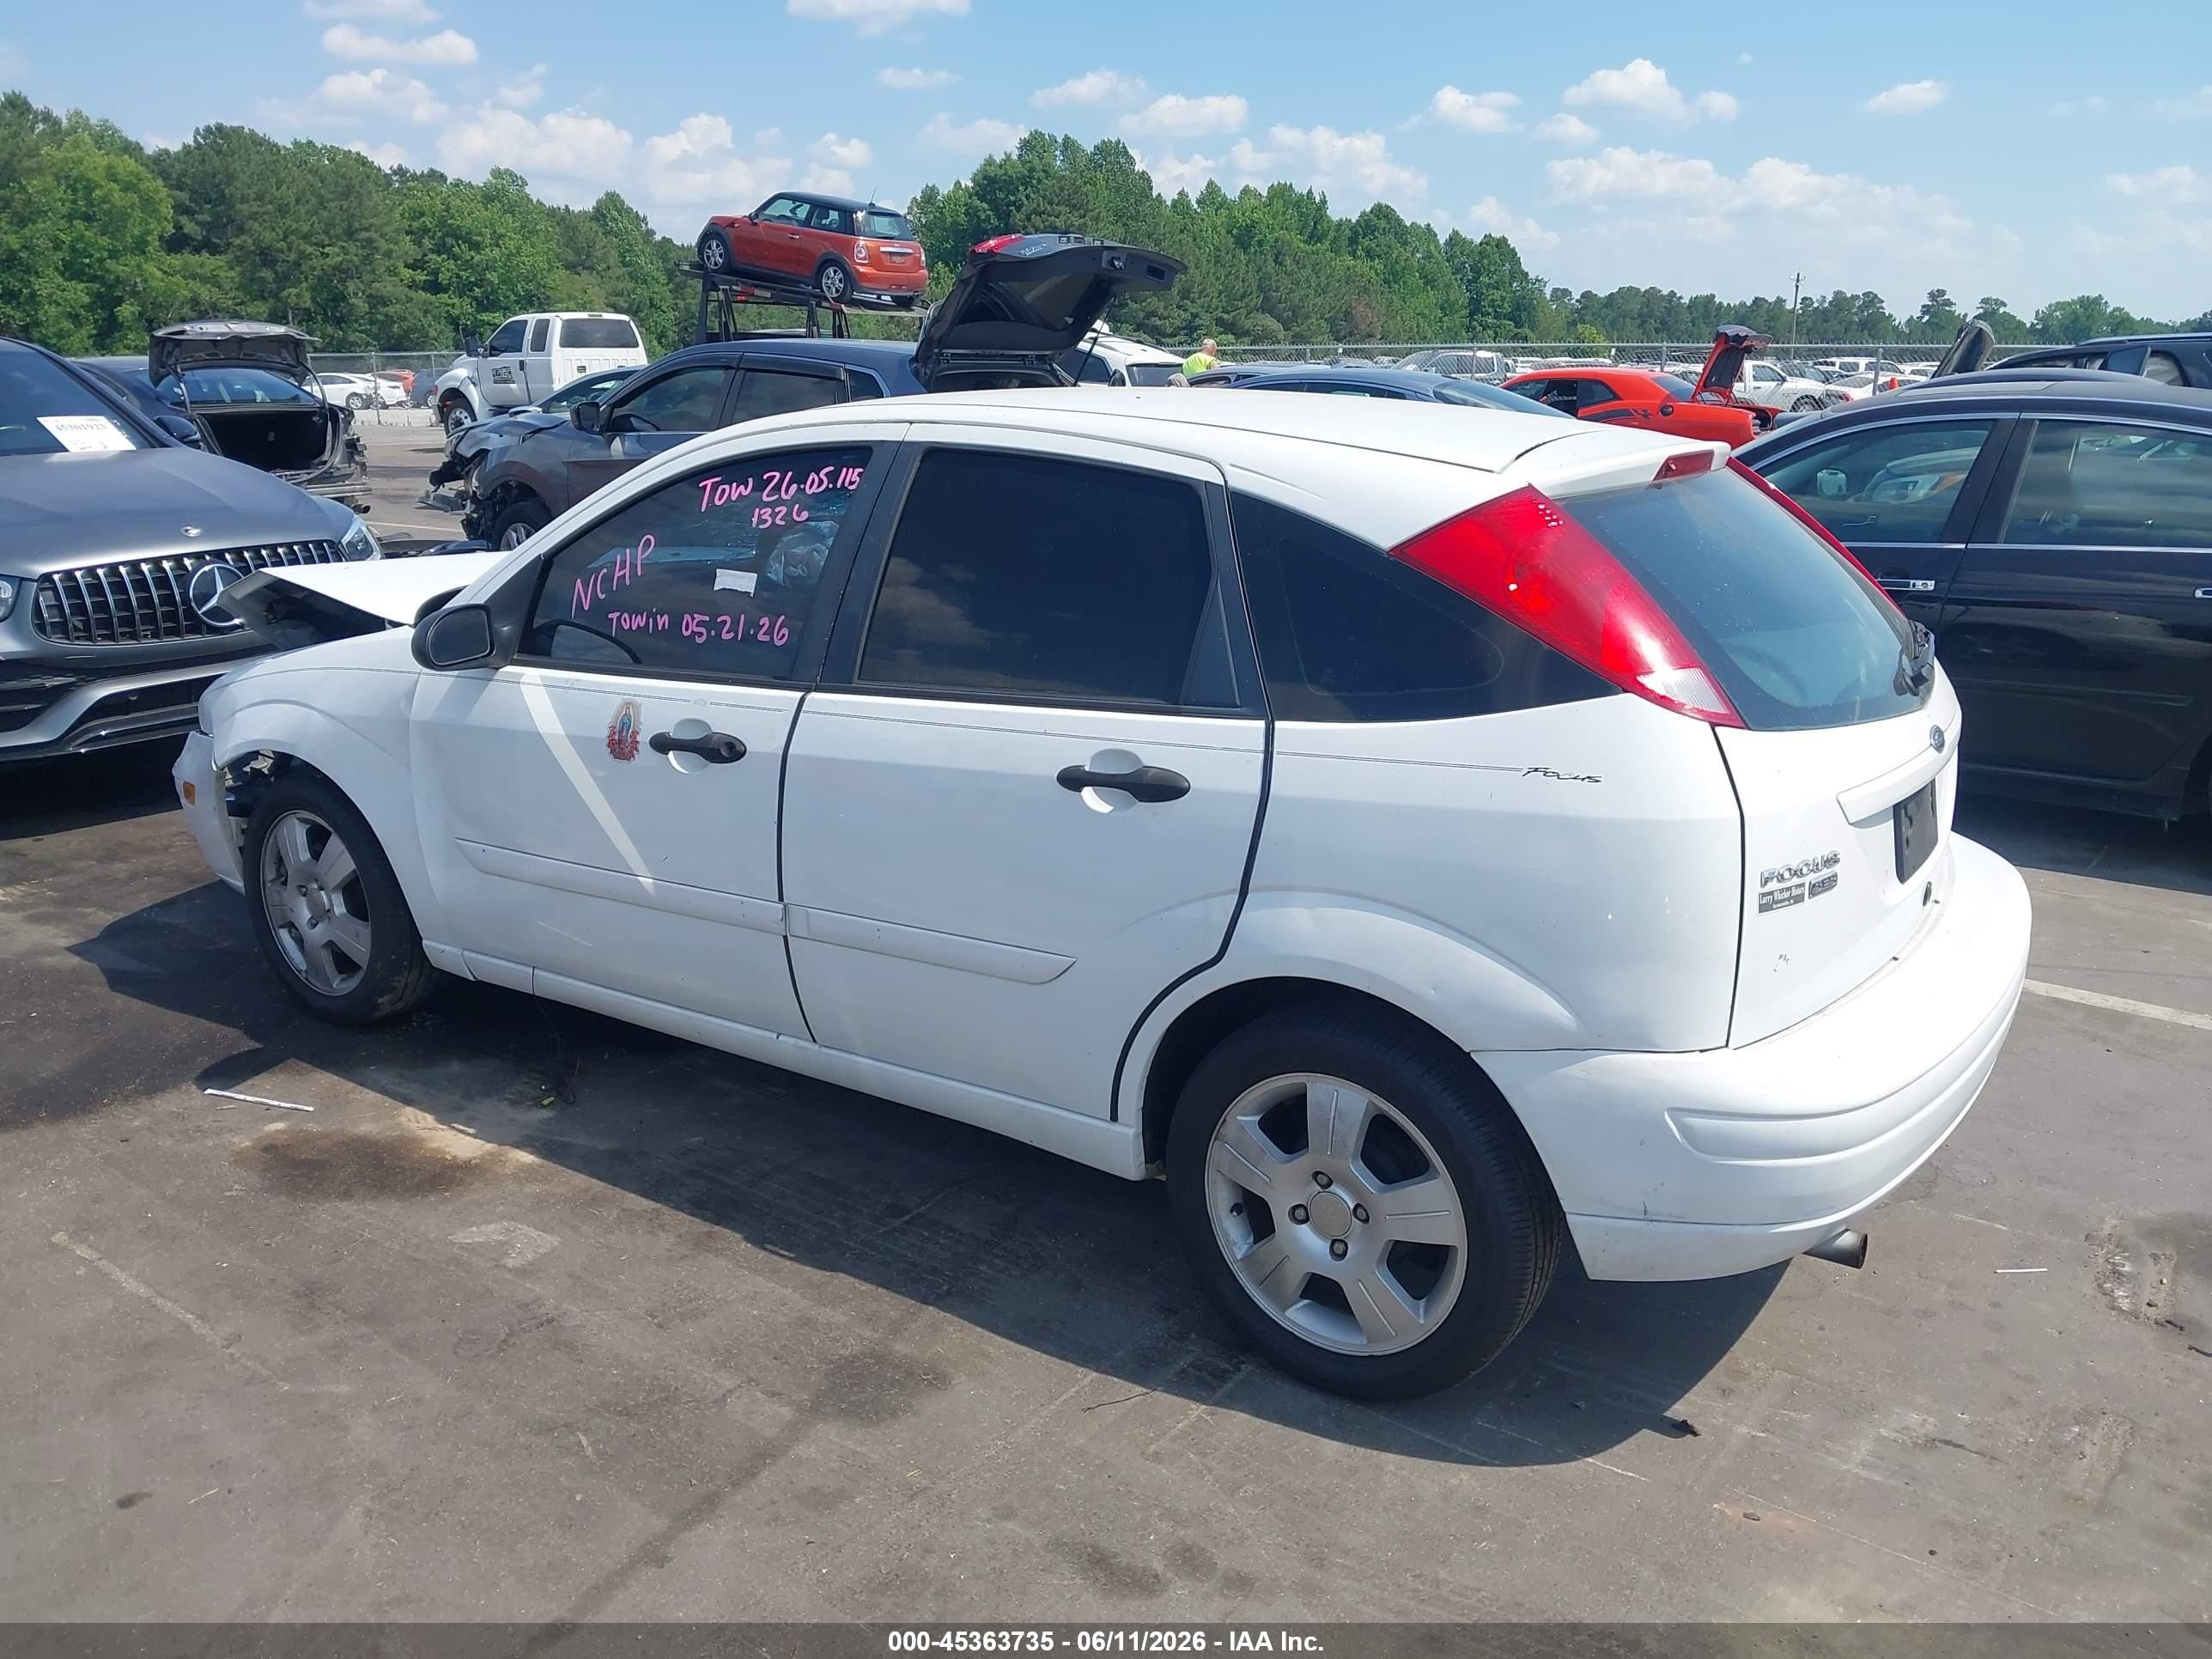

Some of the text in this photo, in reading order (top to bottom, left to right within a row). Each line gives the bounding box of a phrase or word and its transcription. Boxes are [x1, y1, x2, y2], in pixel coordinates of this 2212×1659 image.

[751, 504, 810, 529] 1326
[571, 534, 655, 618] NCHP
[681, 613, 789, 646] 05.21.26
[1759, 850, 1841, 889] FOCUS
[1811, 873, 1838, 895] SES
[1759, 894, 1772, 906] Larry
